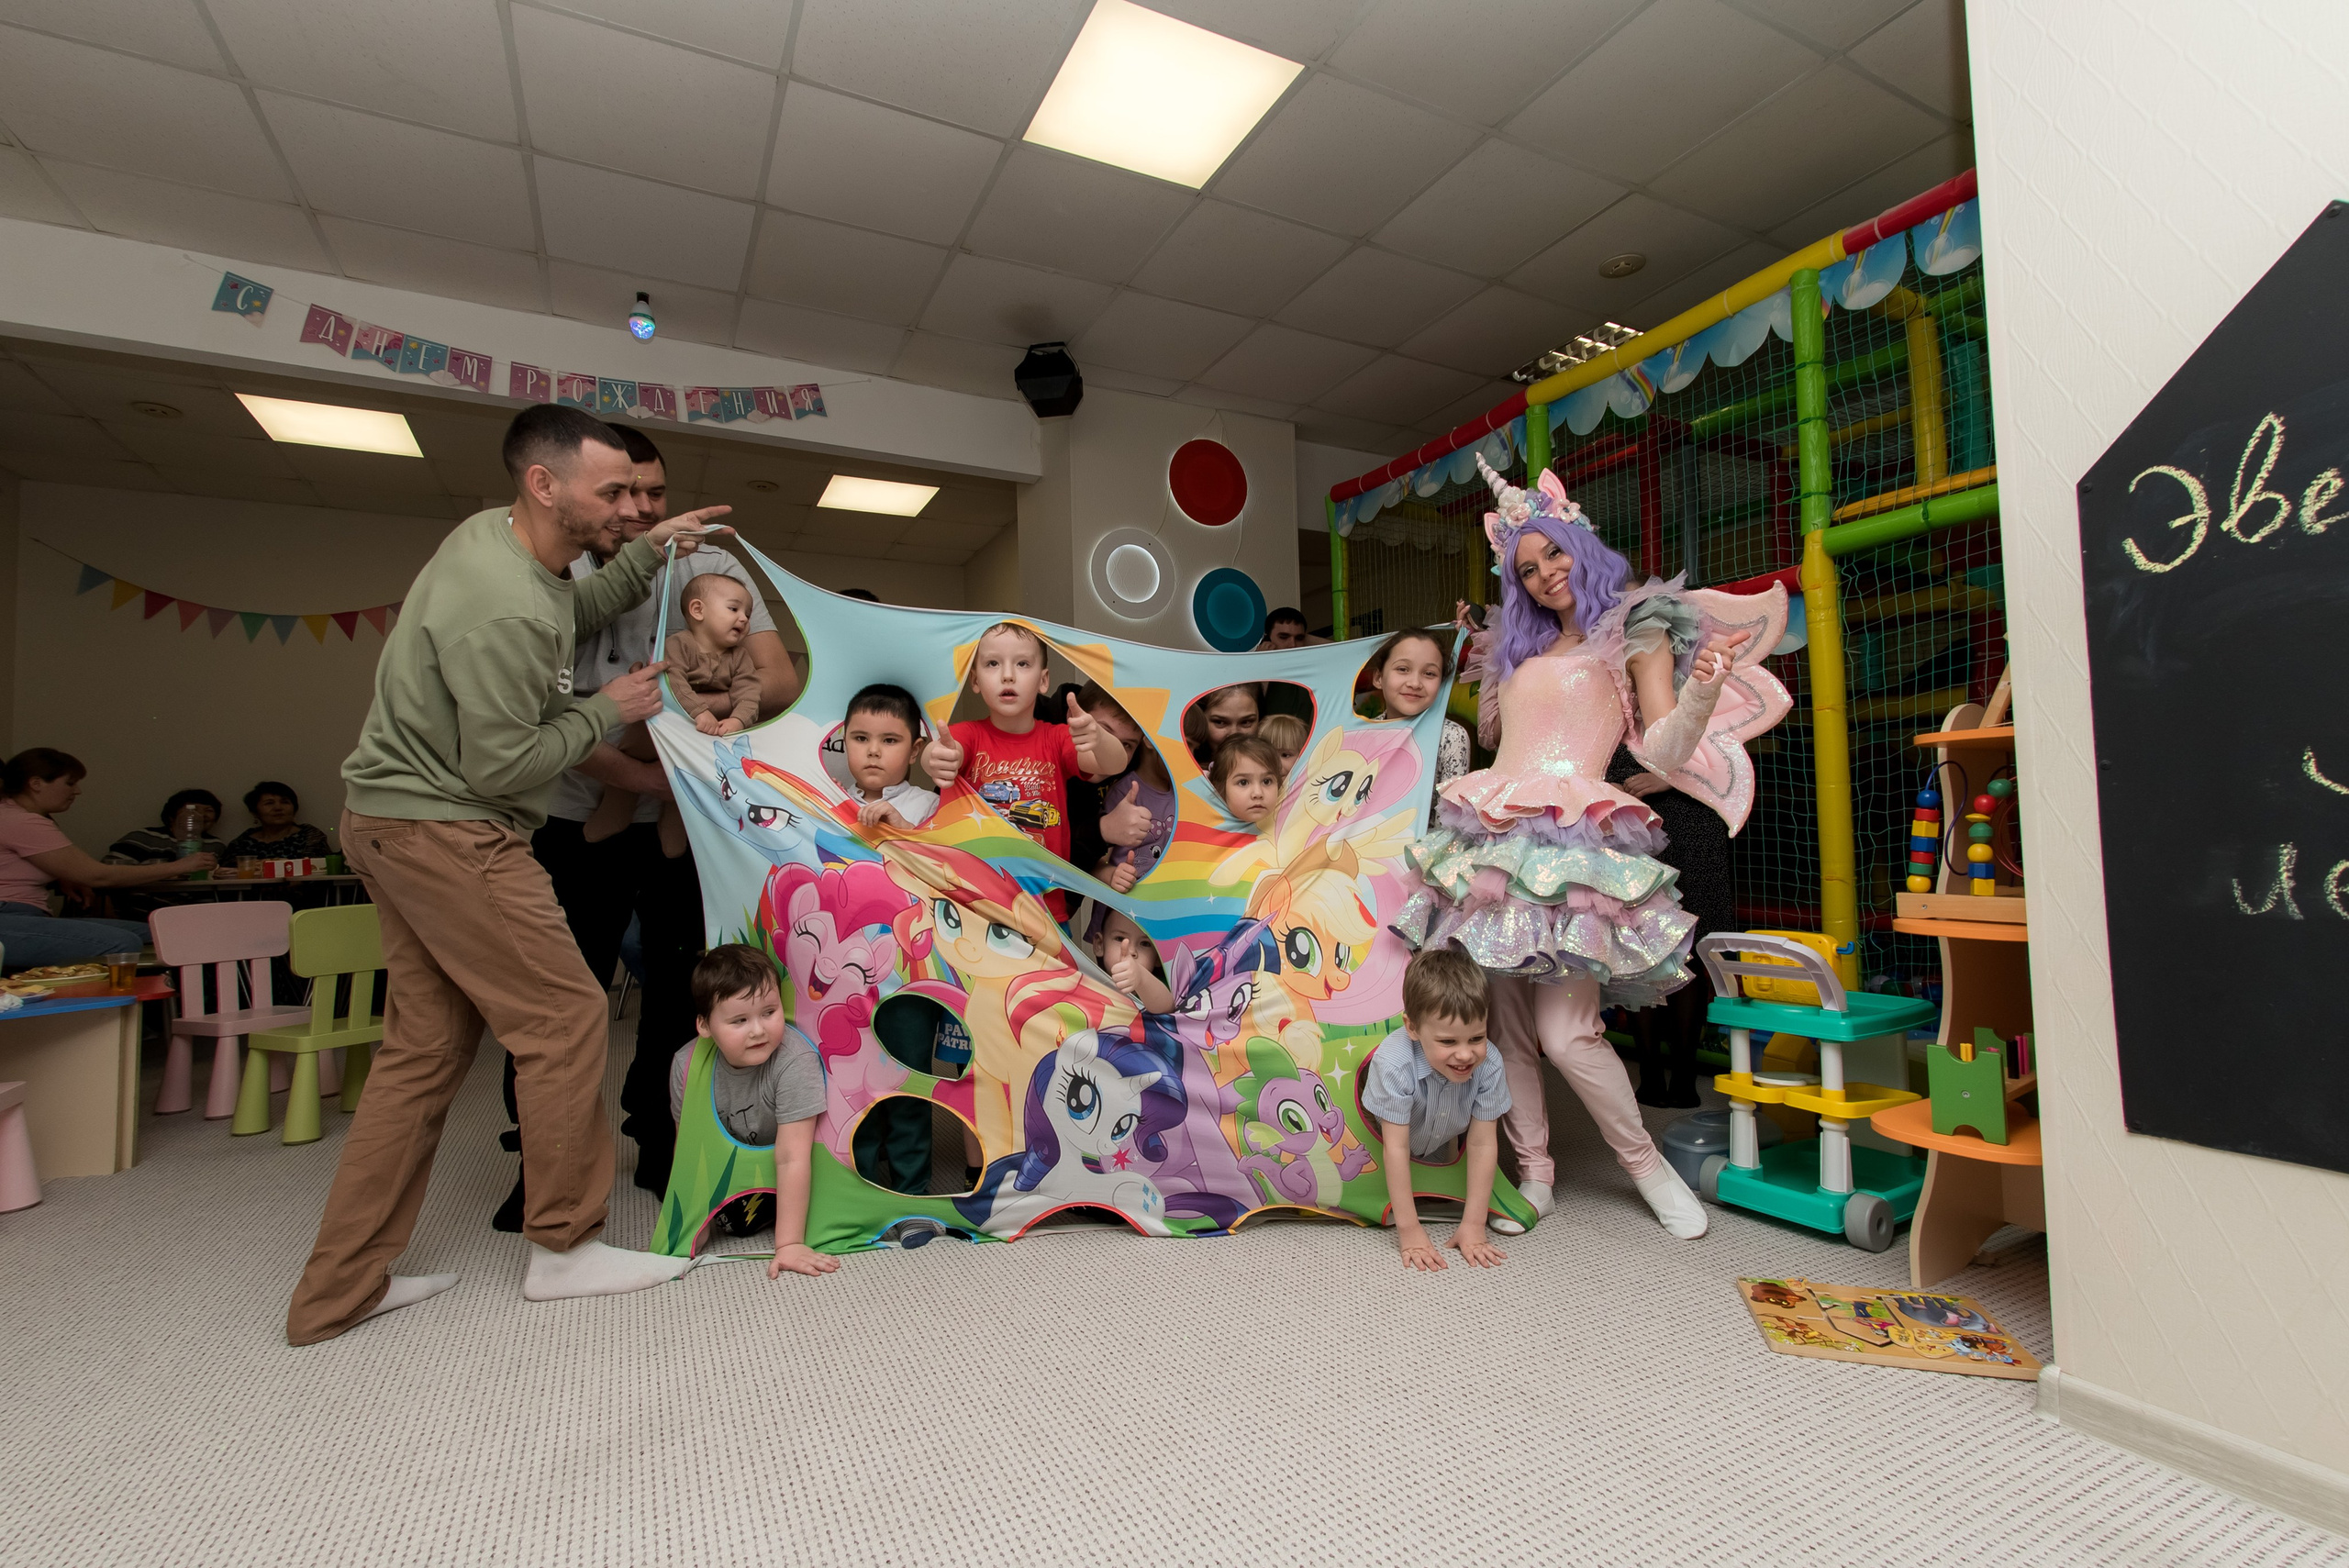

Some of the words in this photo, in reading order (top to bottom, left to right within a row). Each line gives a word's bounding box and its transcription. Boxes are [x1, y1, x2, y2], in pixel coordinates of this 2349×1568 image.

[236, 284, 254, 311] С
[317, 315, 479, 384] ДНЕМ
[525, 369, 816, 416] РОЖДЕНИЯ
